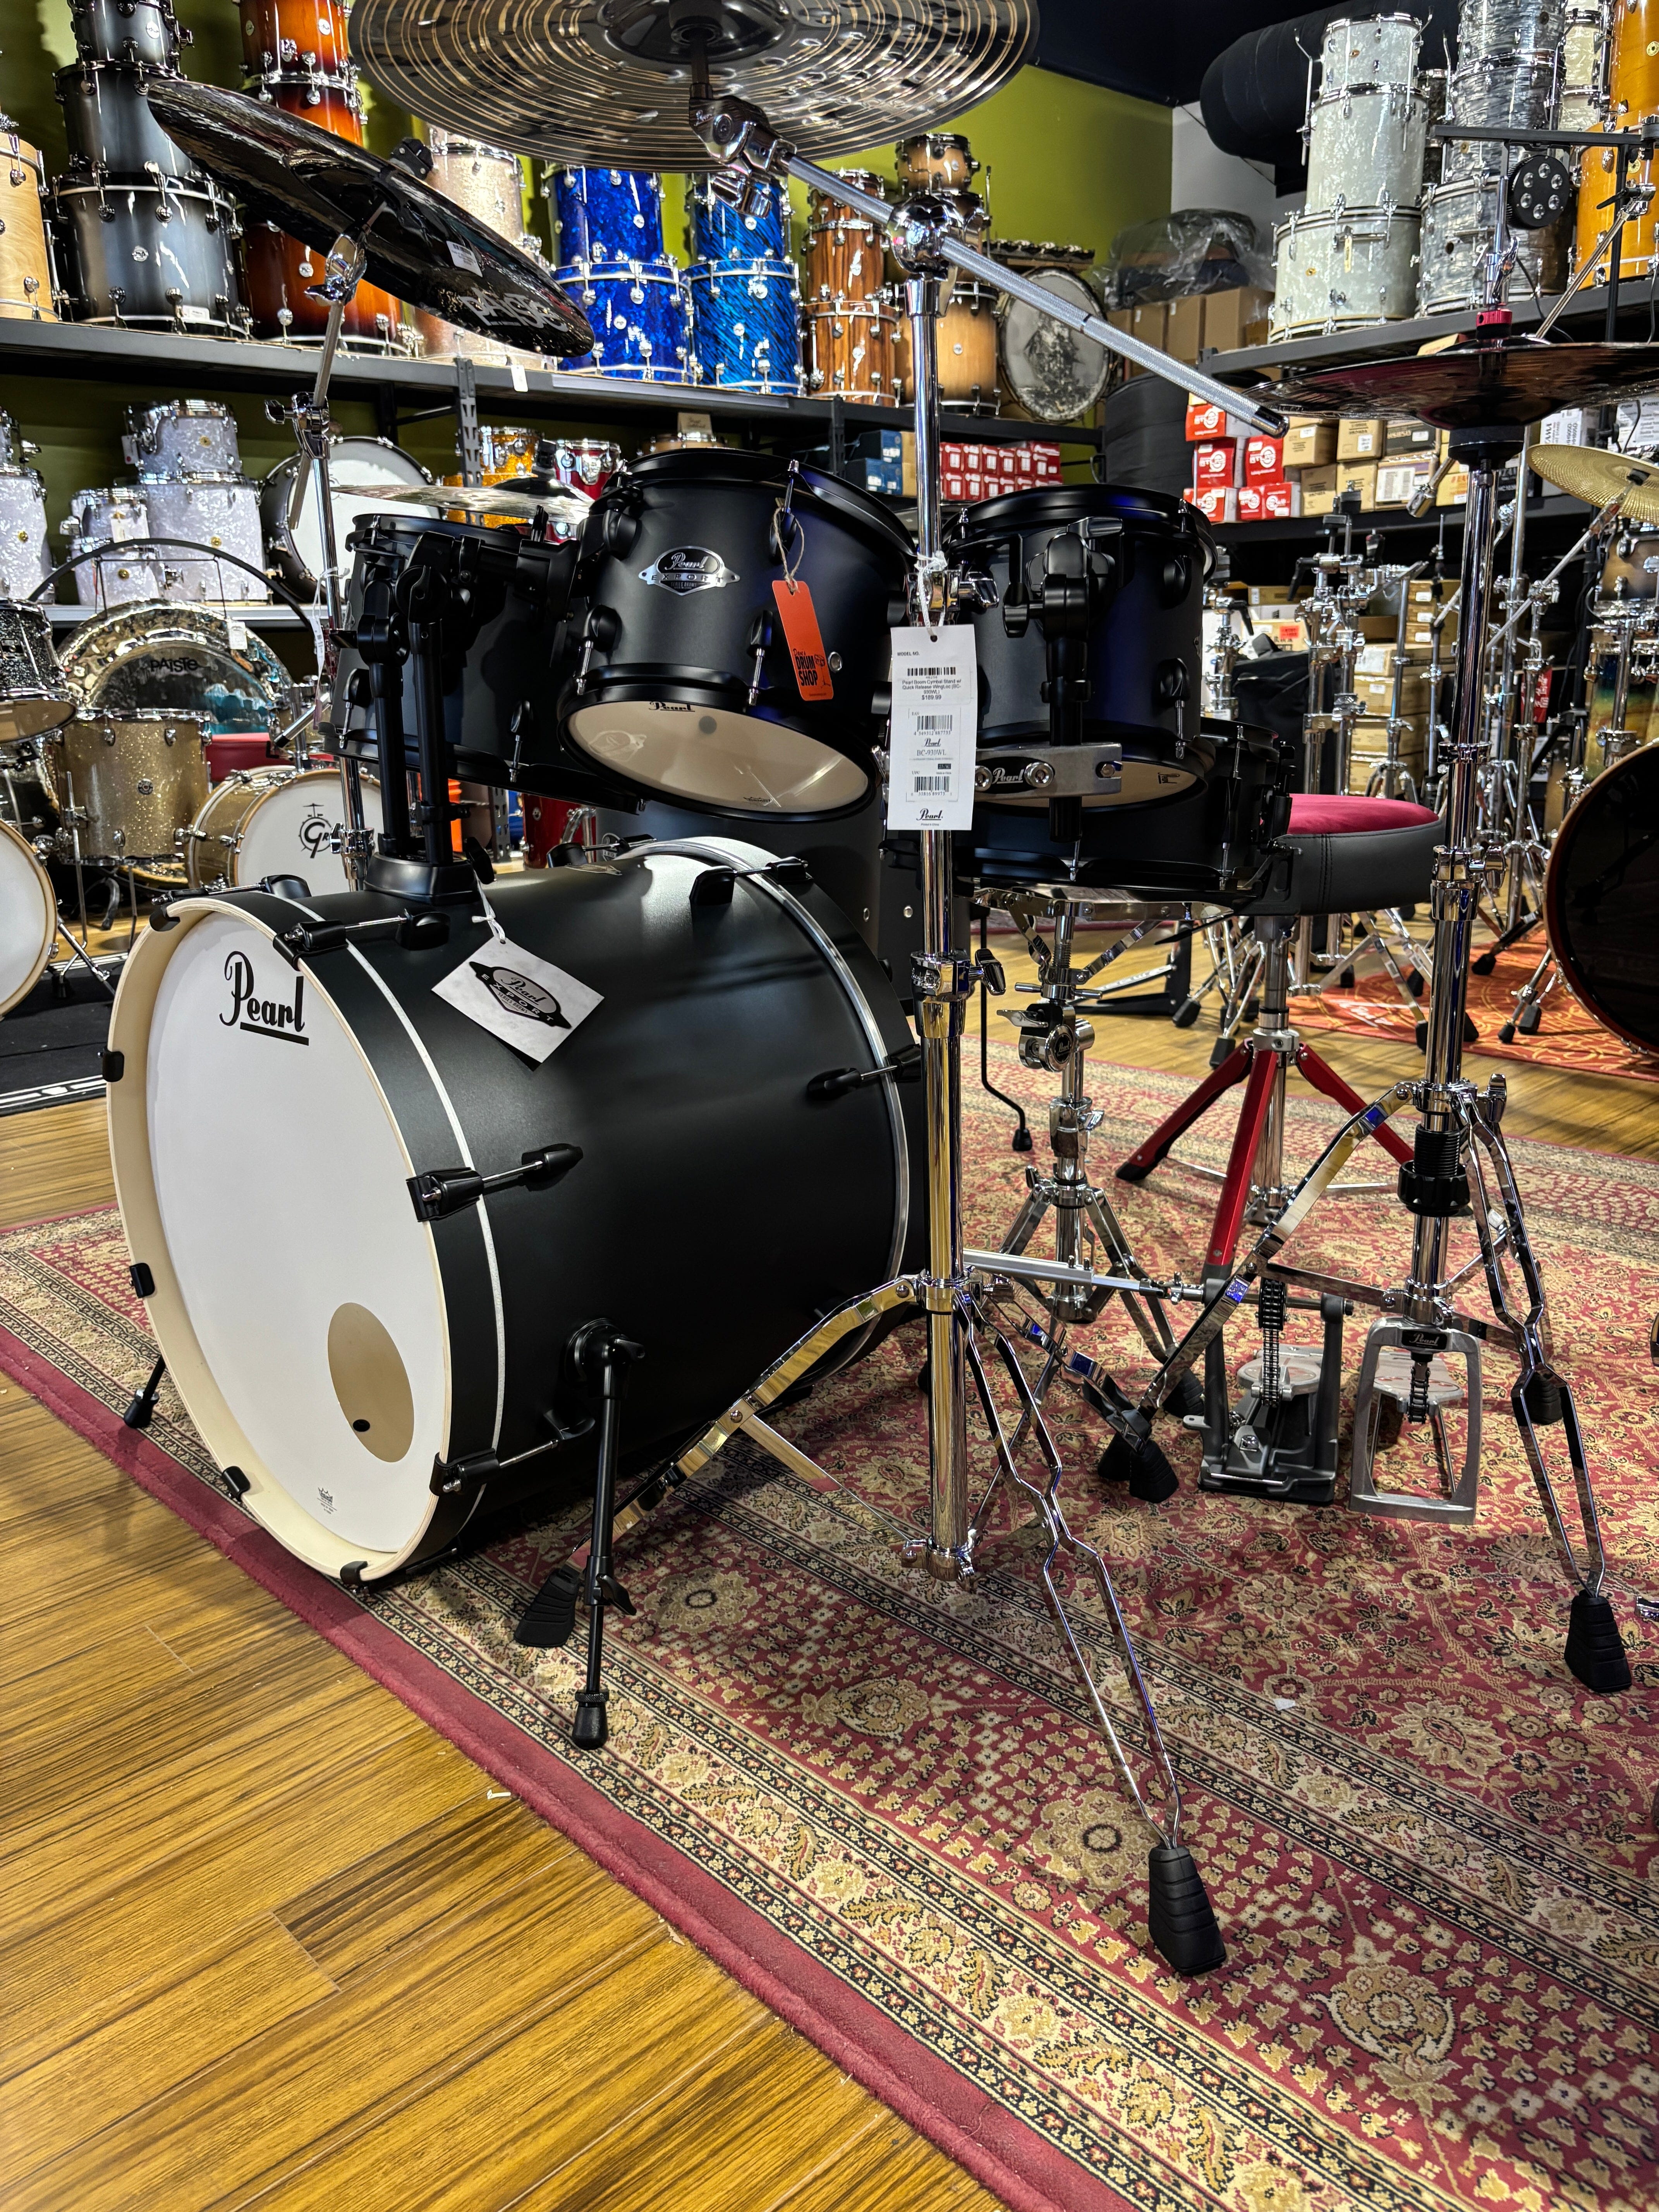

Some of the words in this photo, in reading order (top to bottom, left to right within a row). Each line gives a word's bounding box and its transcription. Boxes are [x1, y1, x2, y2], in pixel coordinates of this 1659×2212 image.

[665, 552, 708, 571] Pearl
[651, 574, 723, 583] EXPORT
[795, 656, 816, 670] DRUM
[798, 670, 818, 686] SHOP
[649, 701, 695, 712] Pearl
[924, 738, 941, 747] Pearl
[992, 767, 1024, 784] Pearl
[916, 808, 943, 821] Pearl
[219, 951, 307, 1036] Pearl
[481, 974, 554, 1021] EXPORT
[501, 977, 547, 1005] Pearl
[498, 992, 512, 1004] SERIES
[513, 1001, 528, 1013] DRUMS
[1409, 1332, 1440, 1346] Pearl
